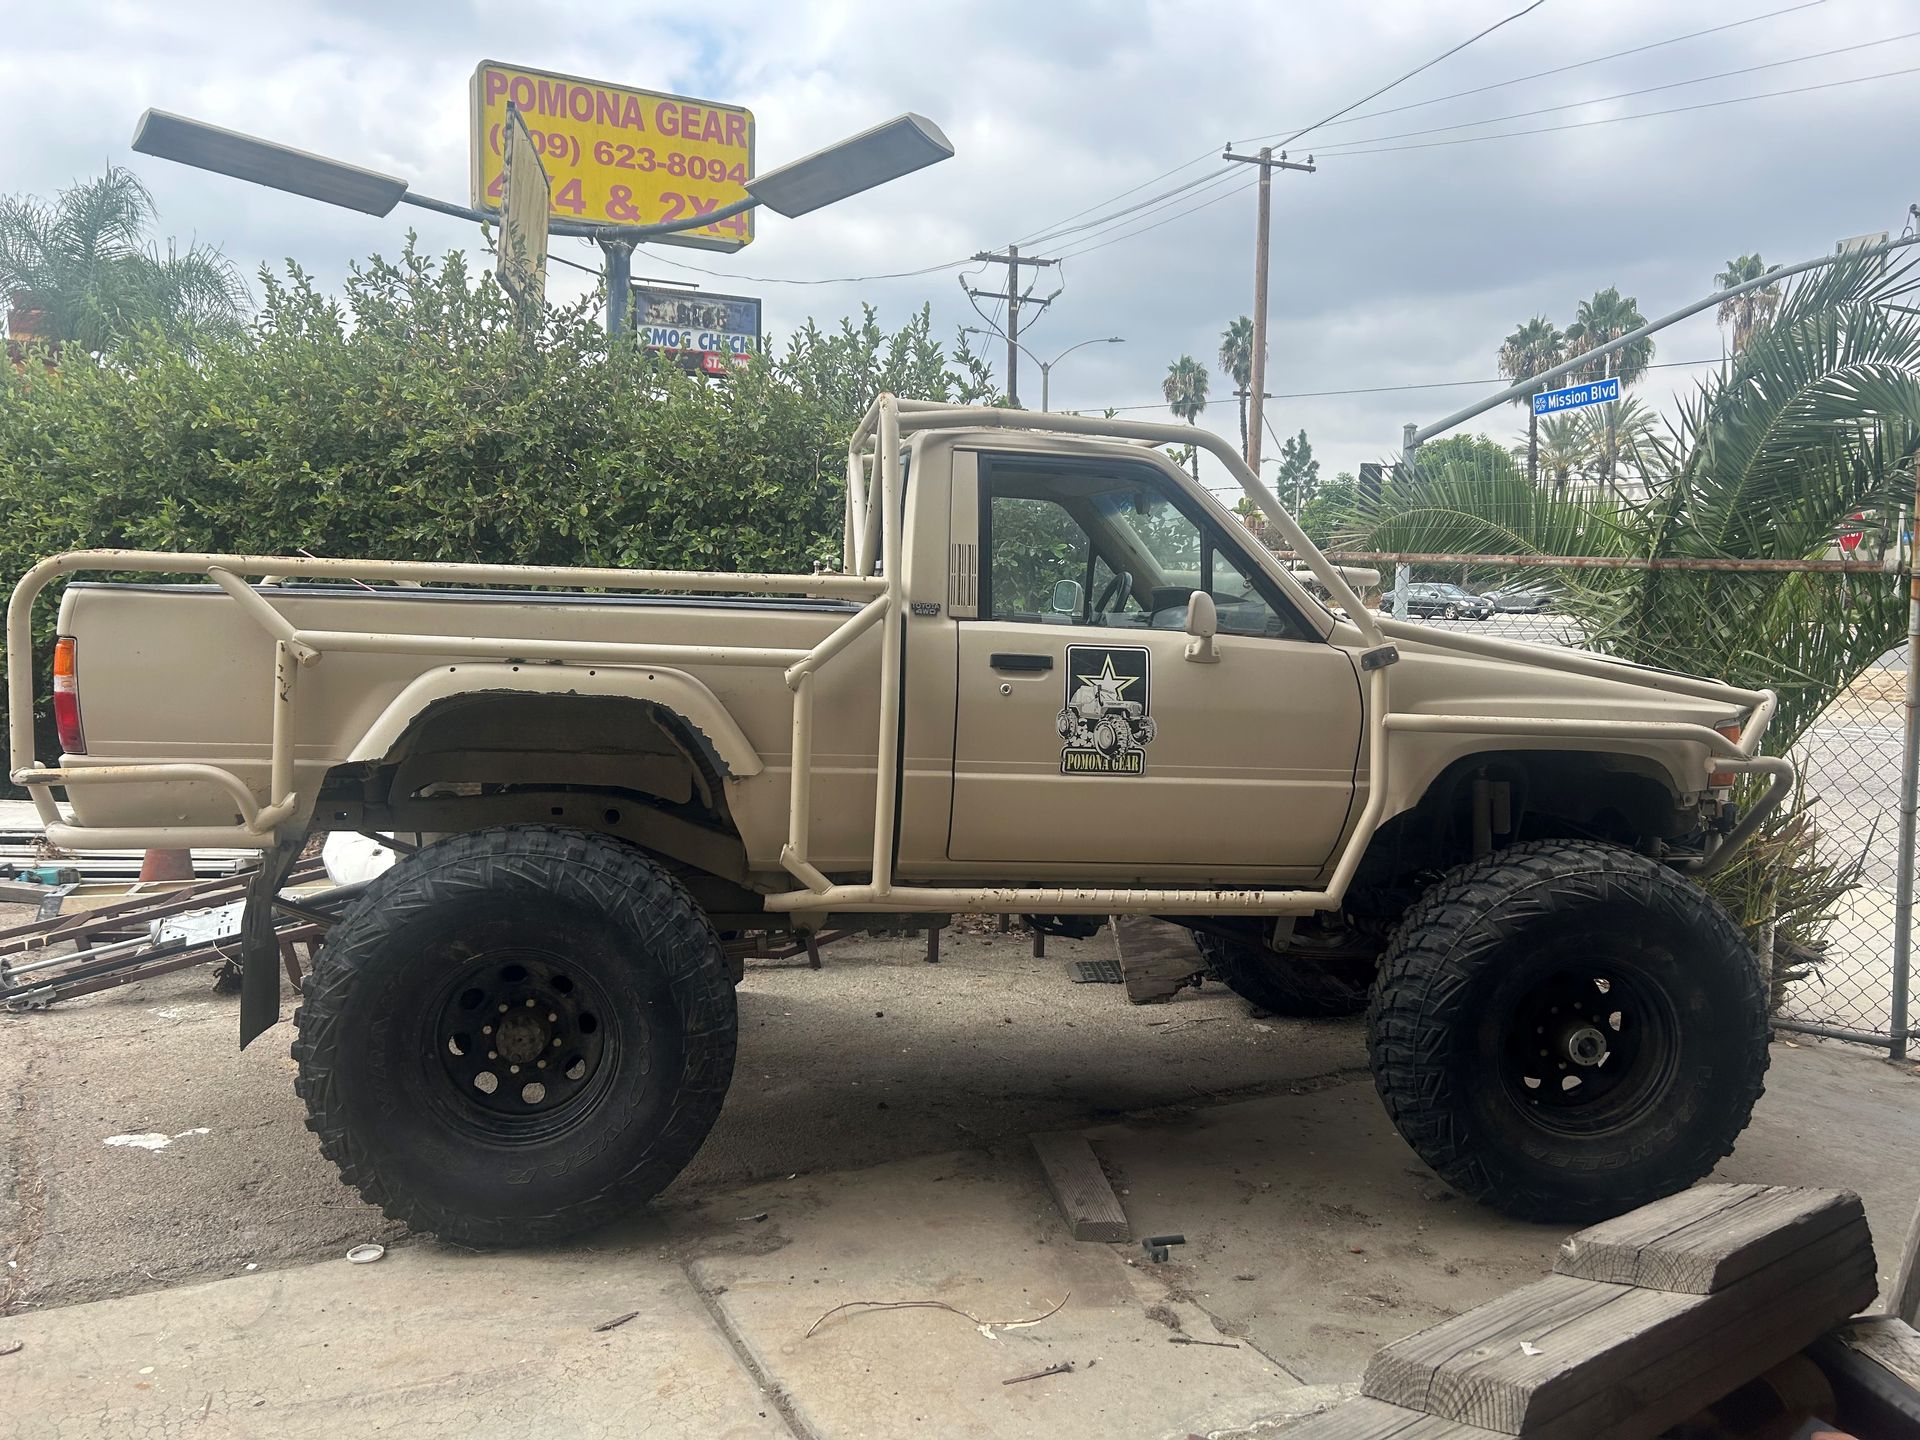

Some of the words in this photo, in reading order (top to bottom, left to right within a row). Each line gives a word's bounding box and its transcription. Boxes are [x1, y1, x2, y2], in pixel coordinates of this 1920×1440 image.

[485, 70, 645, 132] POMONA
[655, 101, 748, 149] GEAR
[489, 123, 581, 168] (09)
[593, 140, 748, 186] 623-8094
[604, 184, 642, 222] &
[642, 327, 691, 348] SMOG
[1548, 390, 1588, 409] Mission
[1590, 382, 1616, 401] Blvd
[1067, 753, 1109, 771] POMONA
[1111, 753, 1139, 772] GEAR
